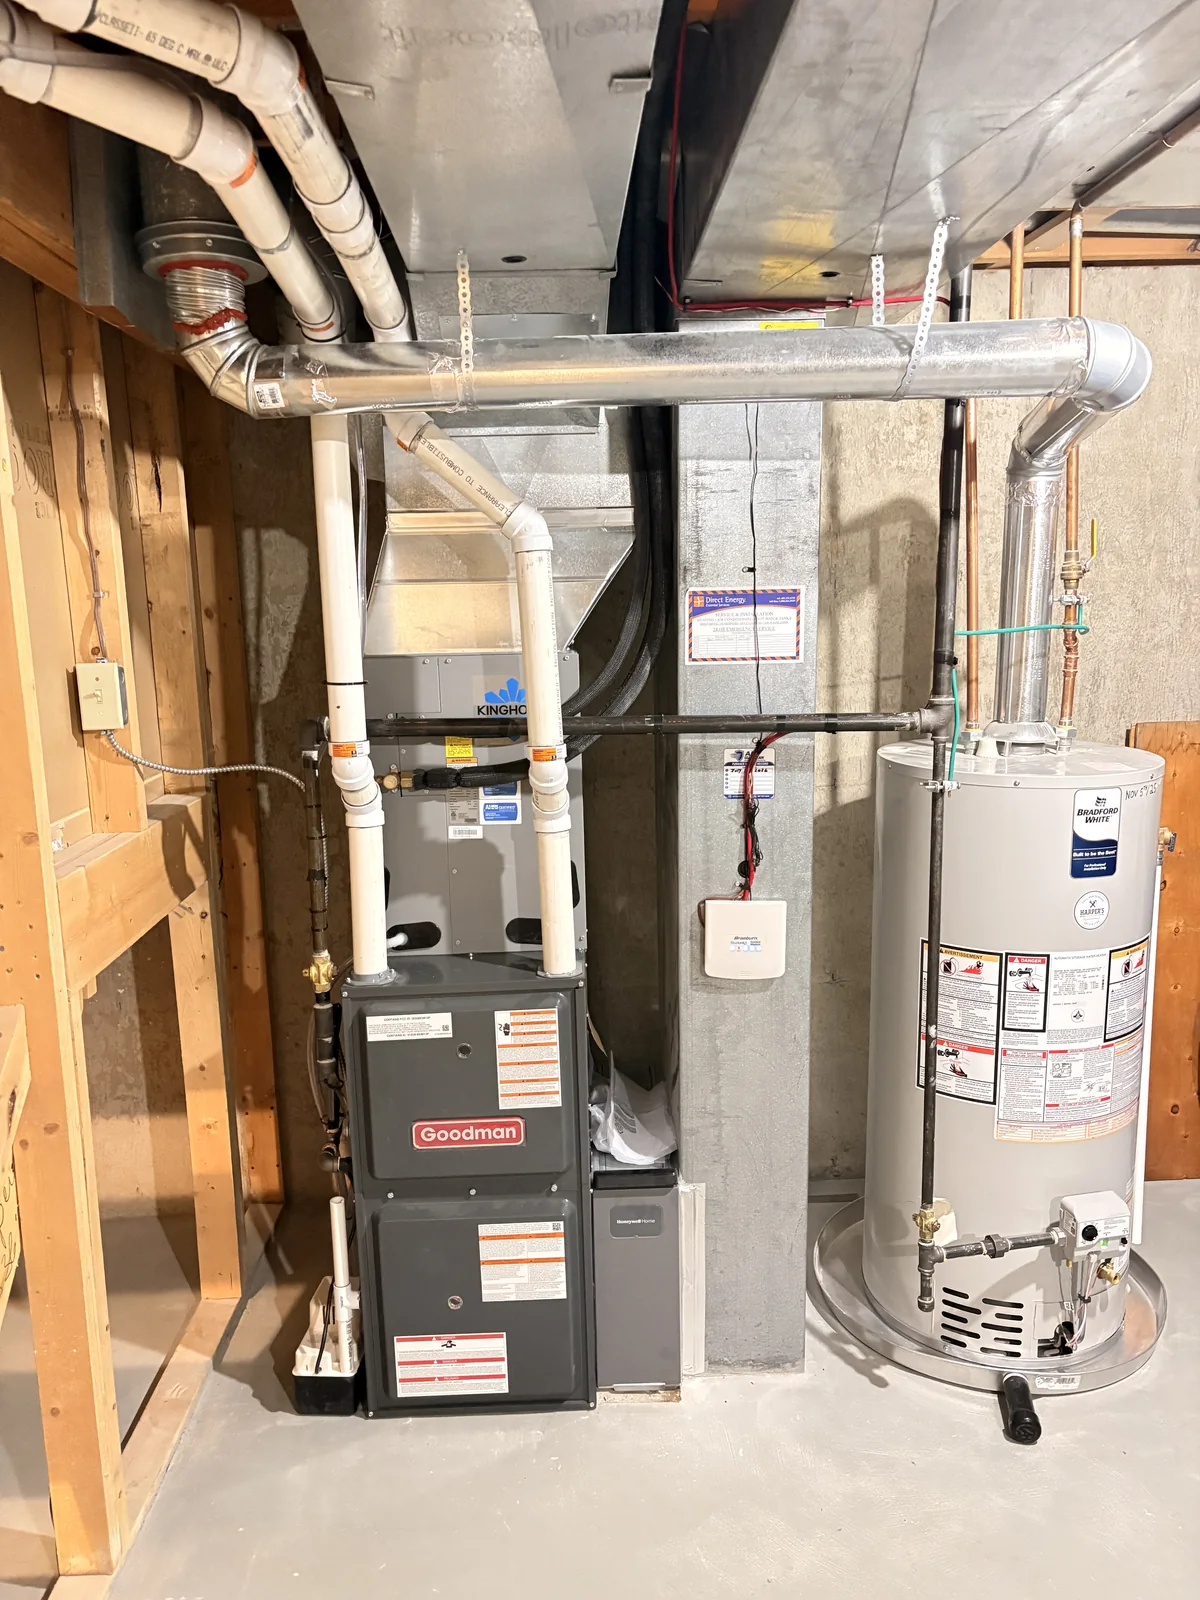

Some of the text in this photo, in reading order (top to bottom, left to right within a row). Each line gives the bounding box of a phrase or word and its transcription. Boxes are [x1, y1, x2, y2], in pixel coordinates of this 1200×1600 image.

[146, 30, 156, 44] 65
[158, 36, 176, 51] DEG
[176, 44, 184, 54] C
[465, 476, 475, 486] TO
[476, 484, 512, 517] CLEARANCE
[725, 596, 744, 604] Energy
[1125, 790, 1138, 800] NOV
[1077, 808, 1118, 816] BRADFORD
[1085, 816, 1110, 824] WHITE
[944, 950, 982, 960] AVERTISSEMENT
[421, 1126, 516, 1142] Goodman
